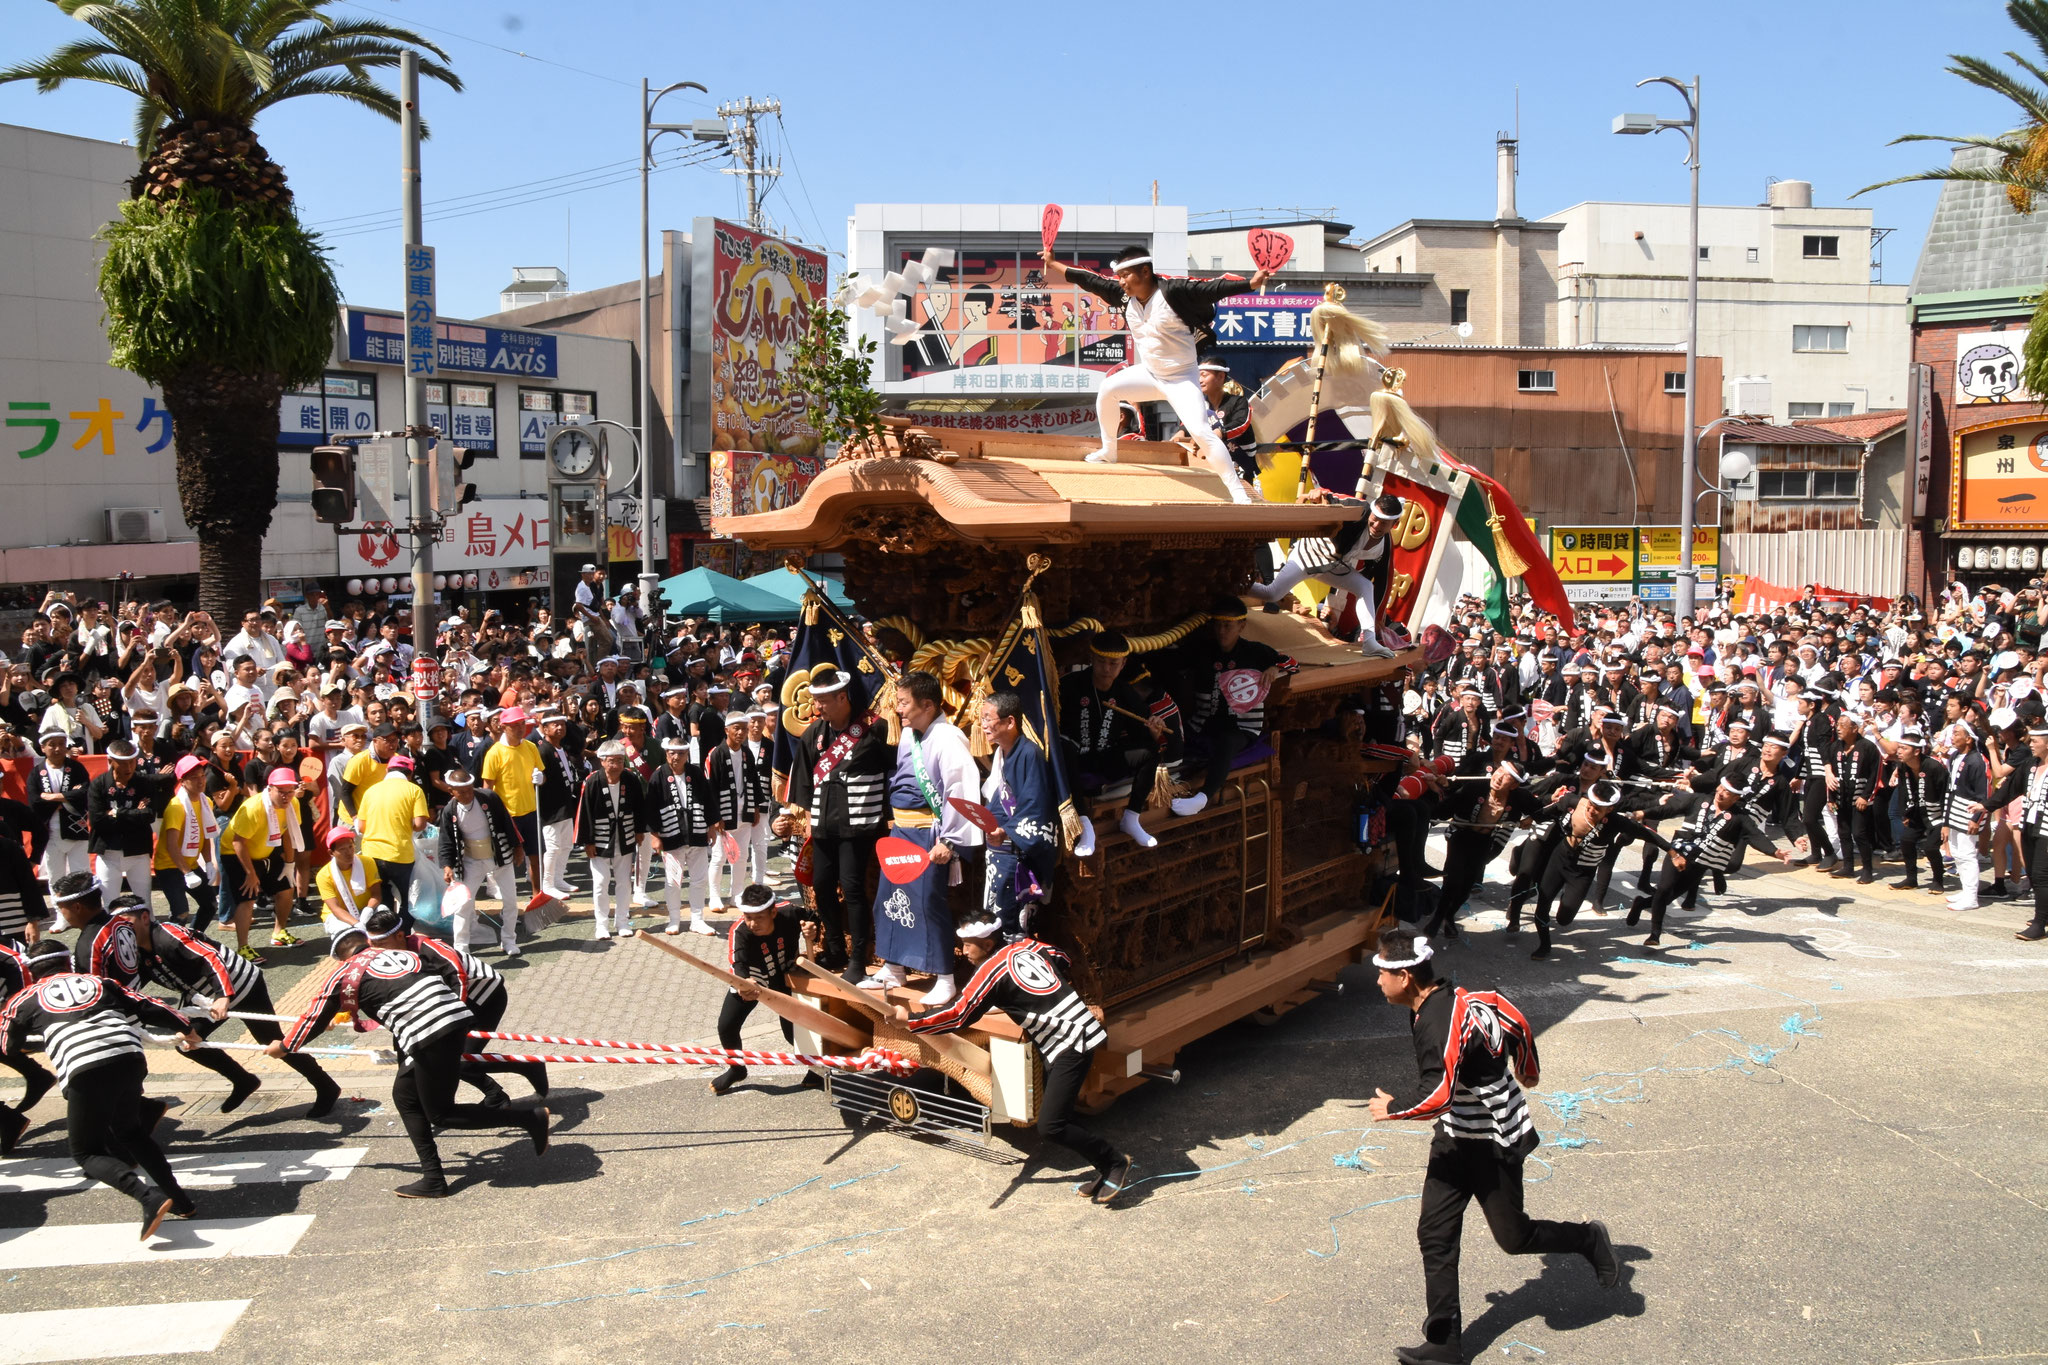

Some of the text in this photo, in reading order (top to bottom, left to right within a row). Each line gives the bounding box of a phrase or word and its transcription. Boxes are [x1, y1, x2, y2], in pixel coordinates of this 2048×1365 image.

[409, 249, 434, 375] 歩車分離式
[501, 331, 543, 346] 全科目対応
[953, 373, 1090, 389] 岸和田駅前通商店街
[524, 394, 551, 409] 受付中
[301, 404, 371, 431] 能開の
[1997, 434, 2016, 474] 泉州
[2000, 506, 2031, 515] IKYU
[1580, 533, 1630, 550] 時間貸
[1557, 556, 1592, 575] 入口
[1567, 588, 1599, 598] PiTaPa
[413, 670, 439, 688] 消火栓
